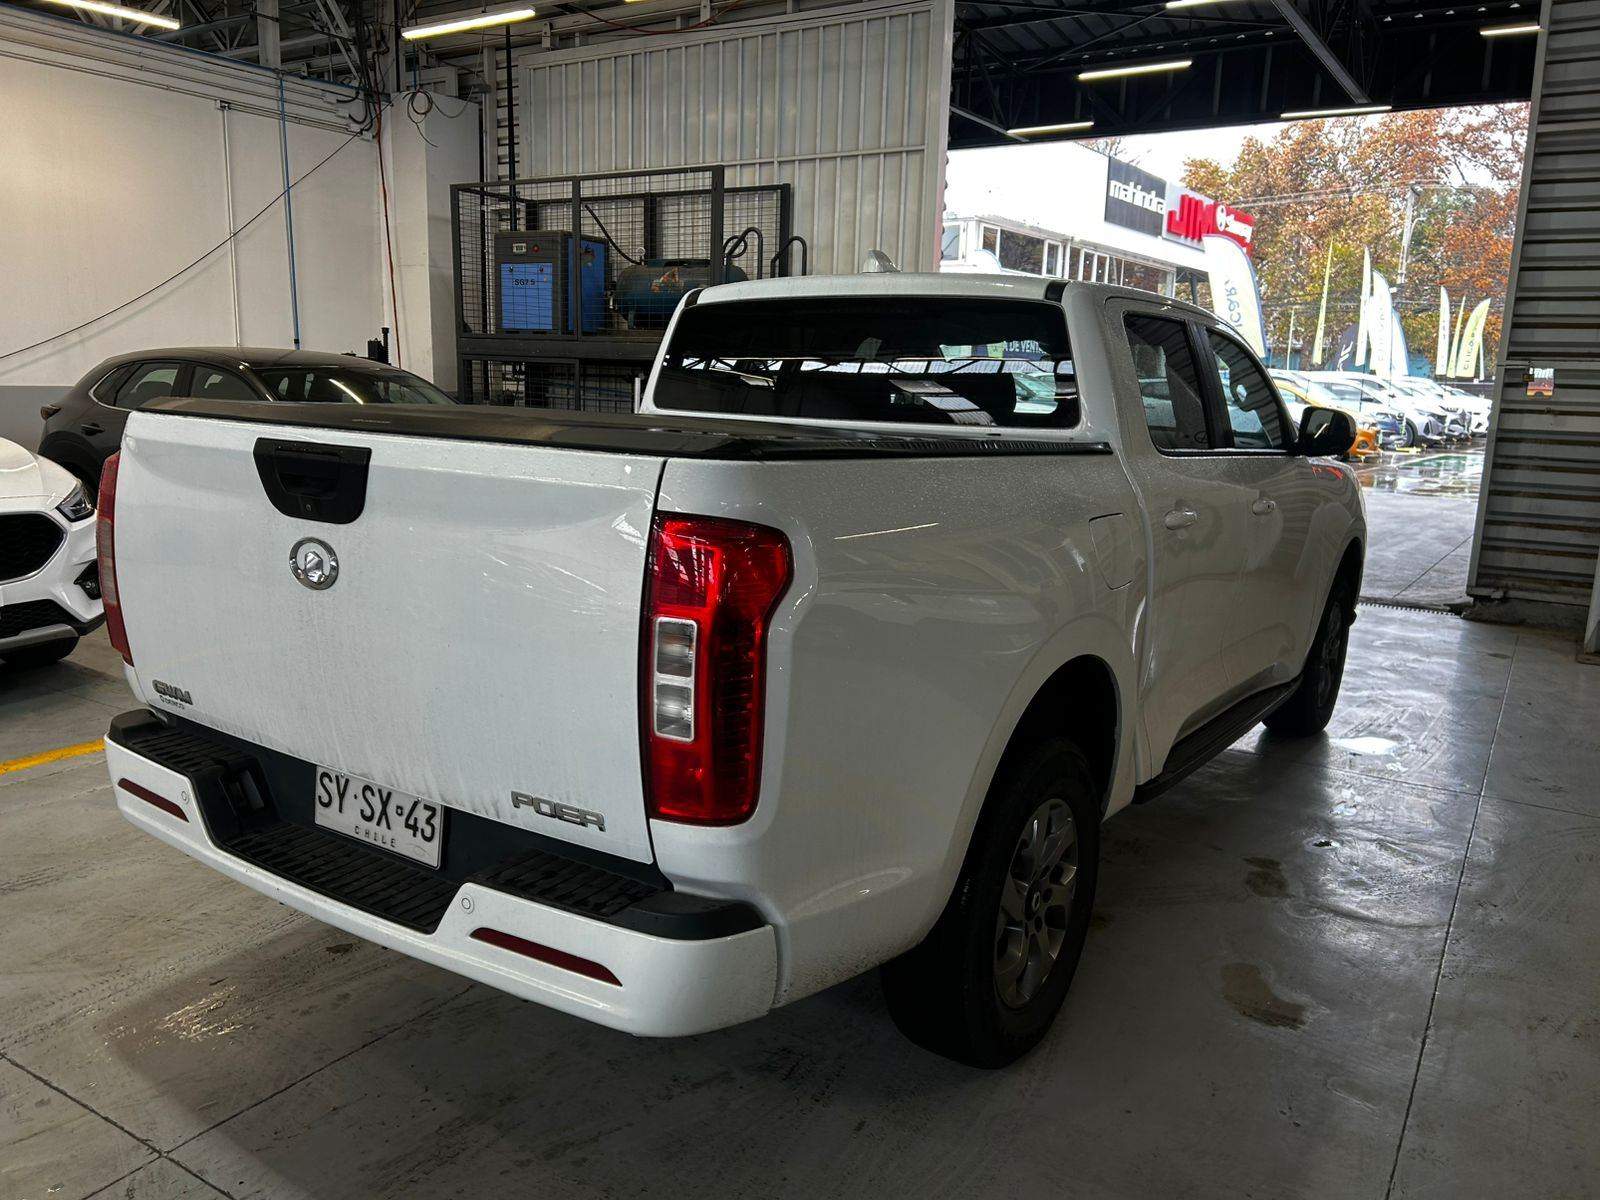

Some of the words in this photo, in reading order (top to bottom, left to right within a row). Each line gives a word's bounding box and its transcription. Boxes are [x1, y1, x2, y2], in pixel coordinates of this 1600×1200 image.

[1109, 179, 1167, 215] mahindra
[511, 790, 606, 832] POER
[354, 825, 397, 848] CHILE
